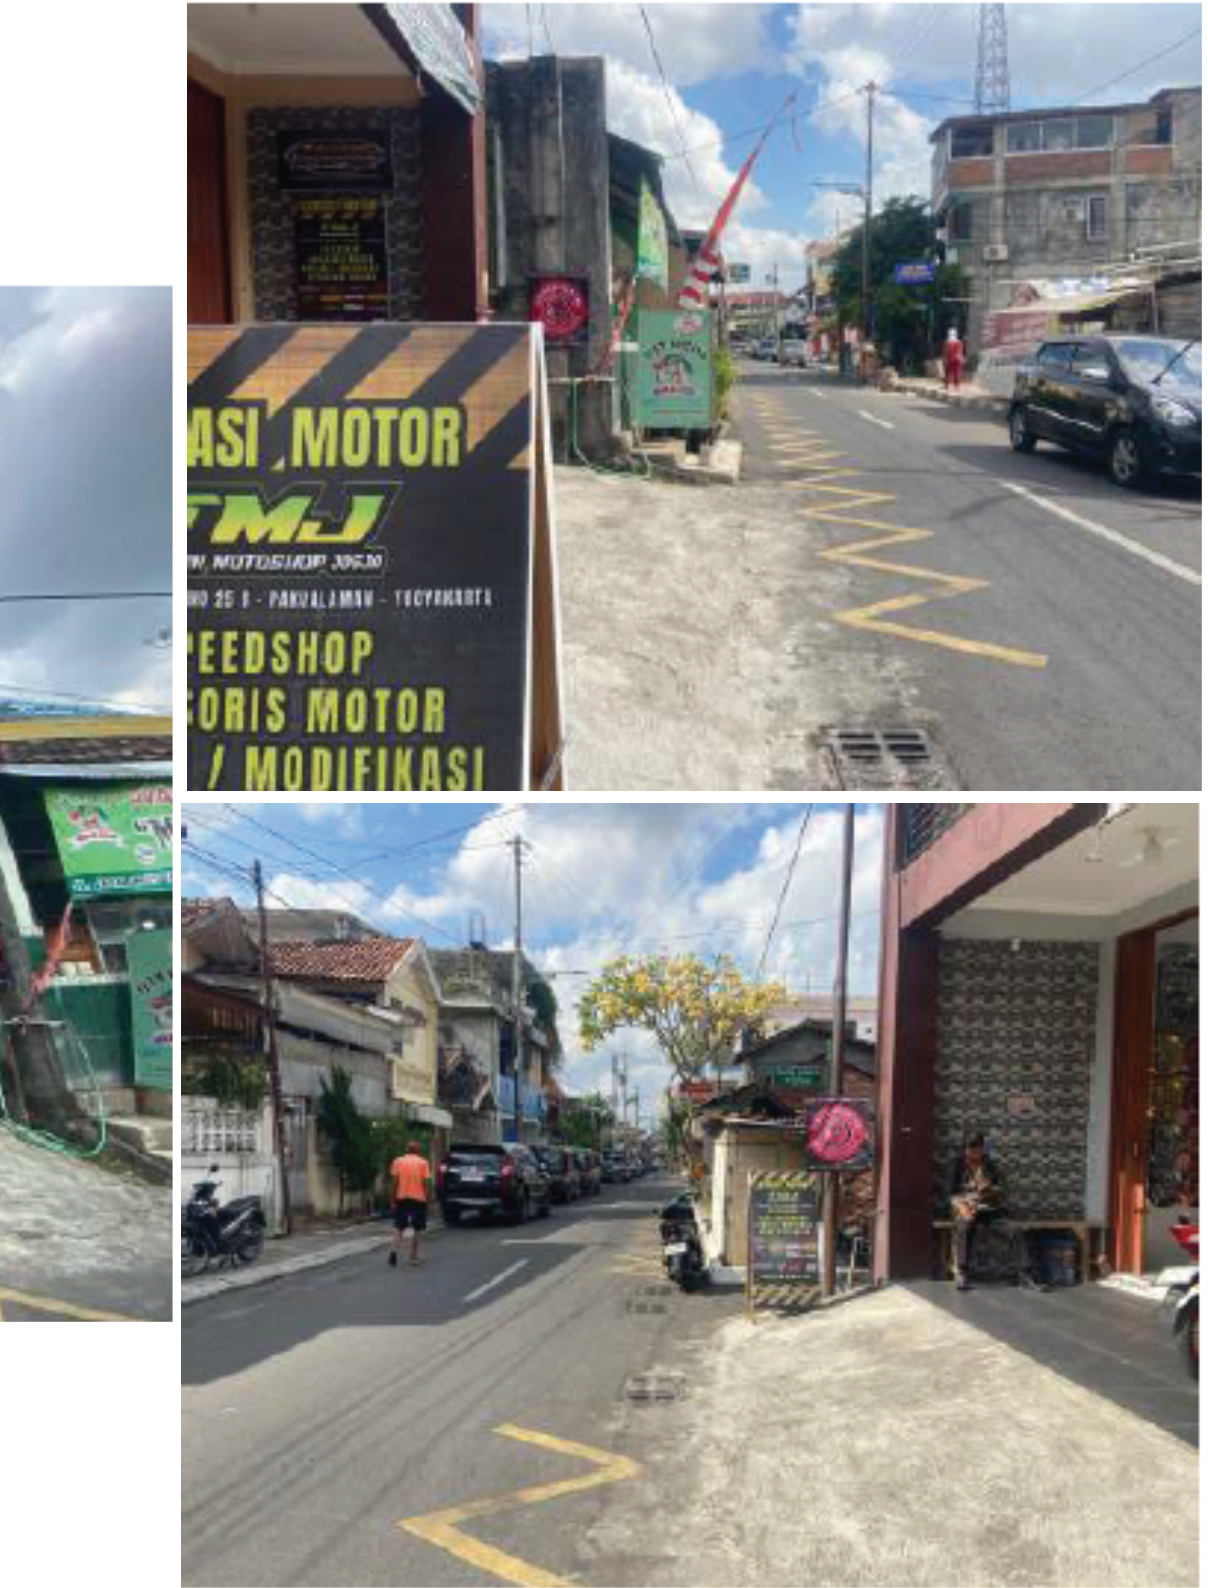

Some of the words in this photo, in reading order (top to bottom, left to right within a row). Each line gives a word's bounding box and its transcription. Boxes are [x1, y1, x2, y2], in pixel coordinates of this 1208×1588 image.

[294, 406, 461, 468] MOTOR
[307, 687, 446, 733] MOTOR
[245, 746, 484, 791] MODIFIKASI
